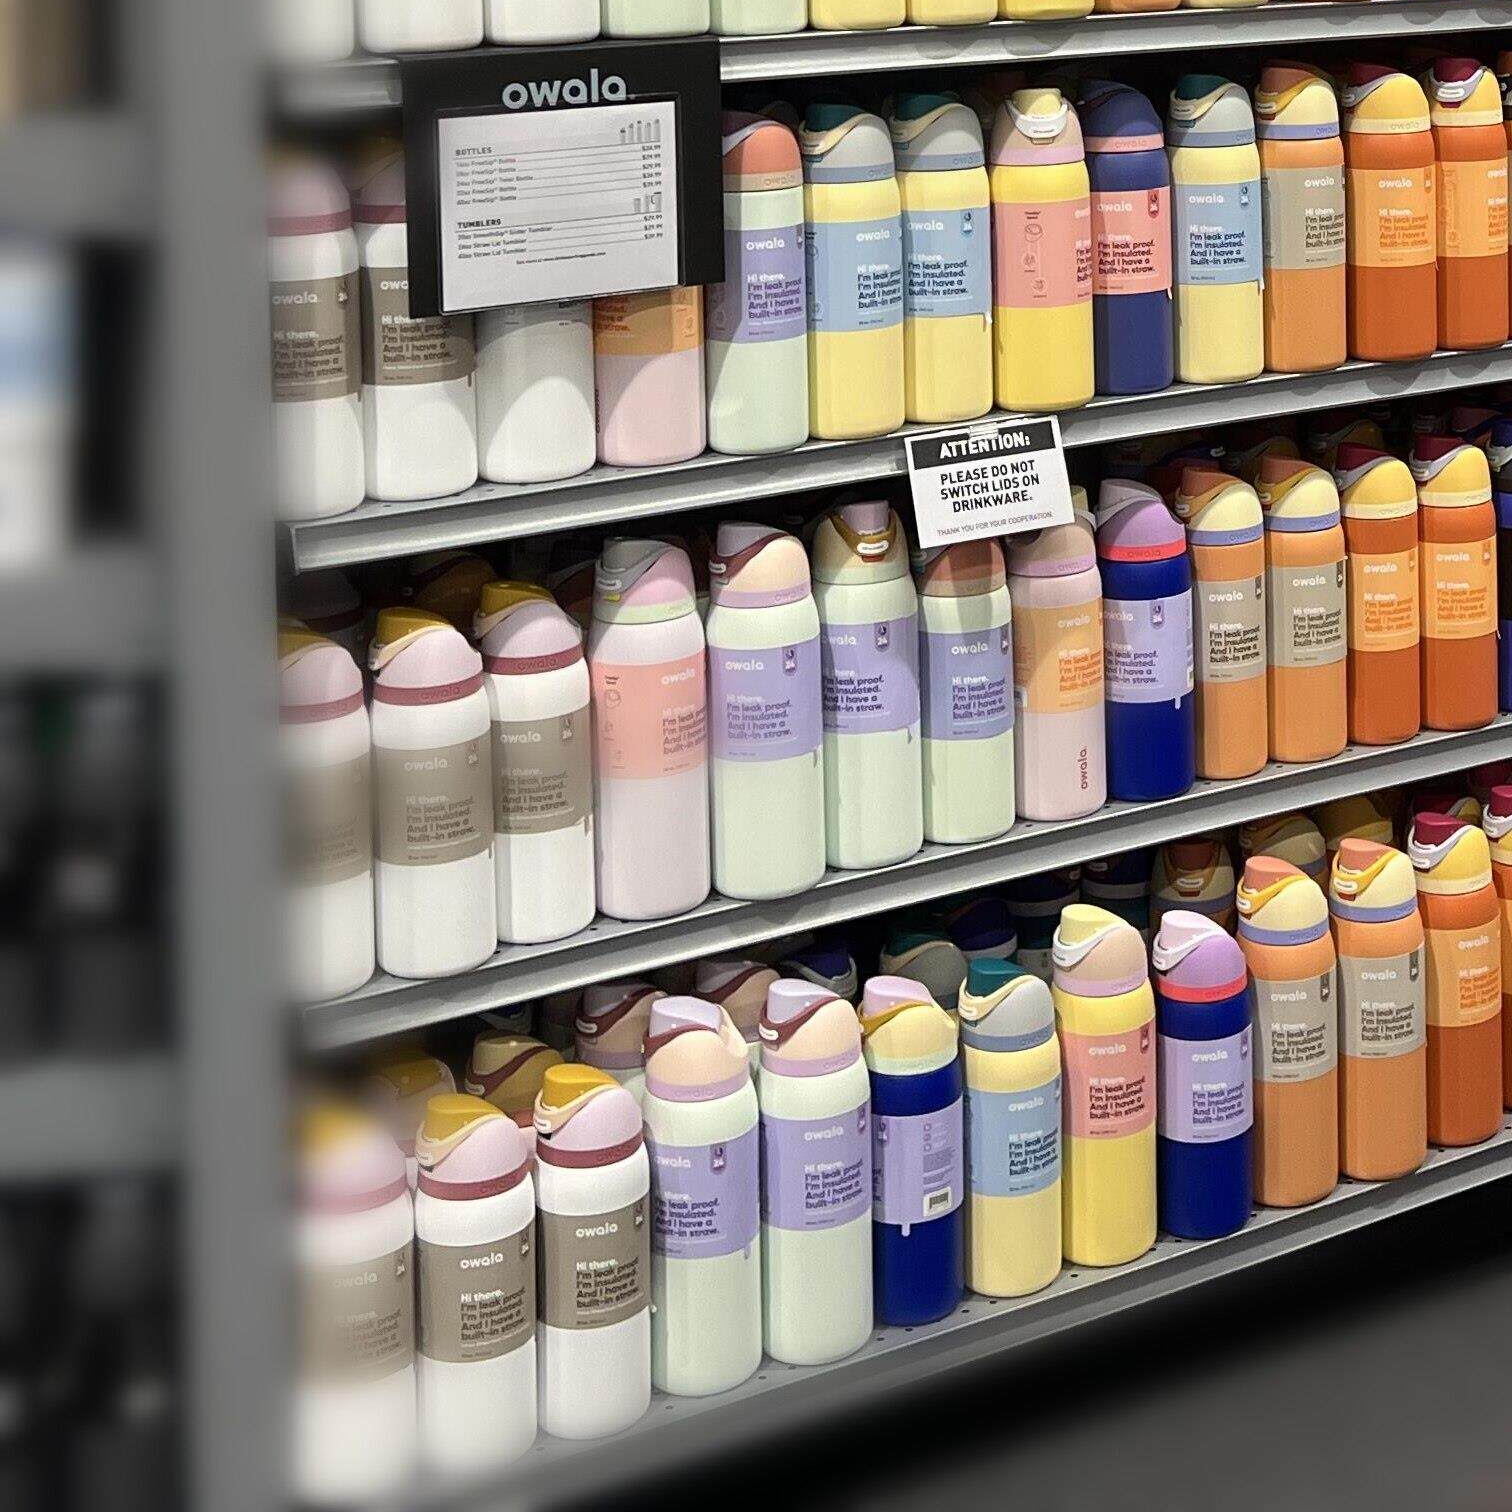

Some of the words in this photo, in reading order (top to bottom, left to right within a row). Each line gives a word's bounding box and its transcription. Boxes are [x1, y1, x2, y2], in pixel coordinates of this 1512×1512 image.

[502, 68, 626, 109] owala
[456, 147, 492, 156] BOTTLES
[1189, 193, 1224, 203] owala
[1097, 202, 1133, 212] owala
[458, 219, 501, 228] TUMBLERS
[1190, 232, 1202, 240] I'm
[1225, 230, 1246, 240] proof.
[1205, 239, 1244, 248] insulated.
[1191, 257, 1221, 265] built-in
[940, 432, 1030, 459] ATTENTION:
[940, 467, 988, 485] PLEASE
[992, 465, 1007, 477] DO
[1012, 460, 1035, 474] NOT
[941, 483, 991, 500] SWITCH
[992, 479, 1020, 491] LIDS
[1023, 474, 1040, 487] ON
[953, 491, 1033, 513] DRINKWARE.
[937, 528, 959, 536] THANK
[1058, 614, 1090, 629] owala
[725, 660, 764, 670] owala
[727, 703, 740, 711] I'm
[742, 703, 762, 711] leak
[765, 699, 792, 712] proof.
[742, 709, 788, 720] insulated.
[728, 722, 745, 730] And
[753, 721, 776, 729] have
[501, 731, 541, 743] owala
[764, 729, 791, 738] straw.
[404, 758, 447, 771] owala
[1077, 746, 1088, 790] owala
[1361, 970, 1398, 980] owala
[1271, 991, 1307, 1002] owala
[1089, 1044, 1126, 1055] owala
[1192, 1049, 1228, 1062] owala
[576, 1223, 618, 1238] owala
[460, 1252, 504, 1269] owala
[461, 1293, 471, 1302] Hi
[461, 1303, 476, 1311] I'm
[479, 1299, 499, 1310] leak
[461, 1313, 476, 1321] I'm
[461, 1322, 482, 1331] And
